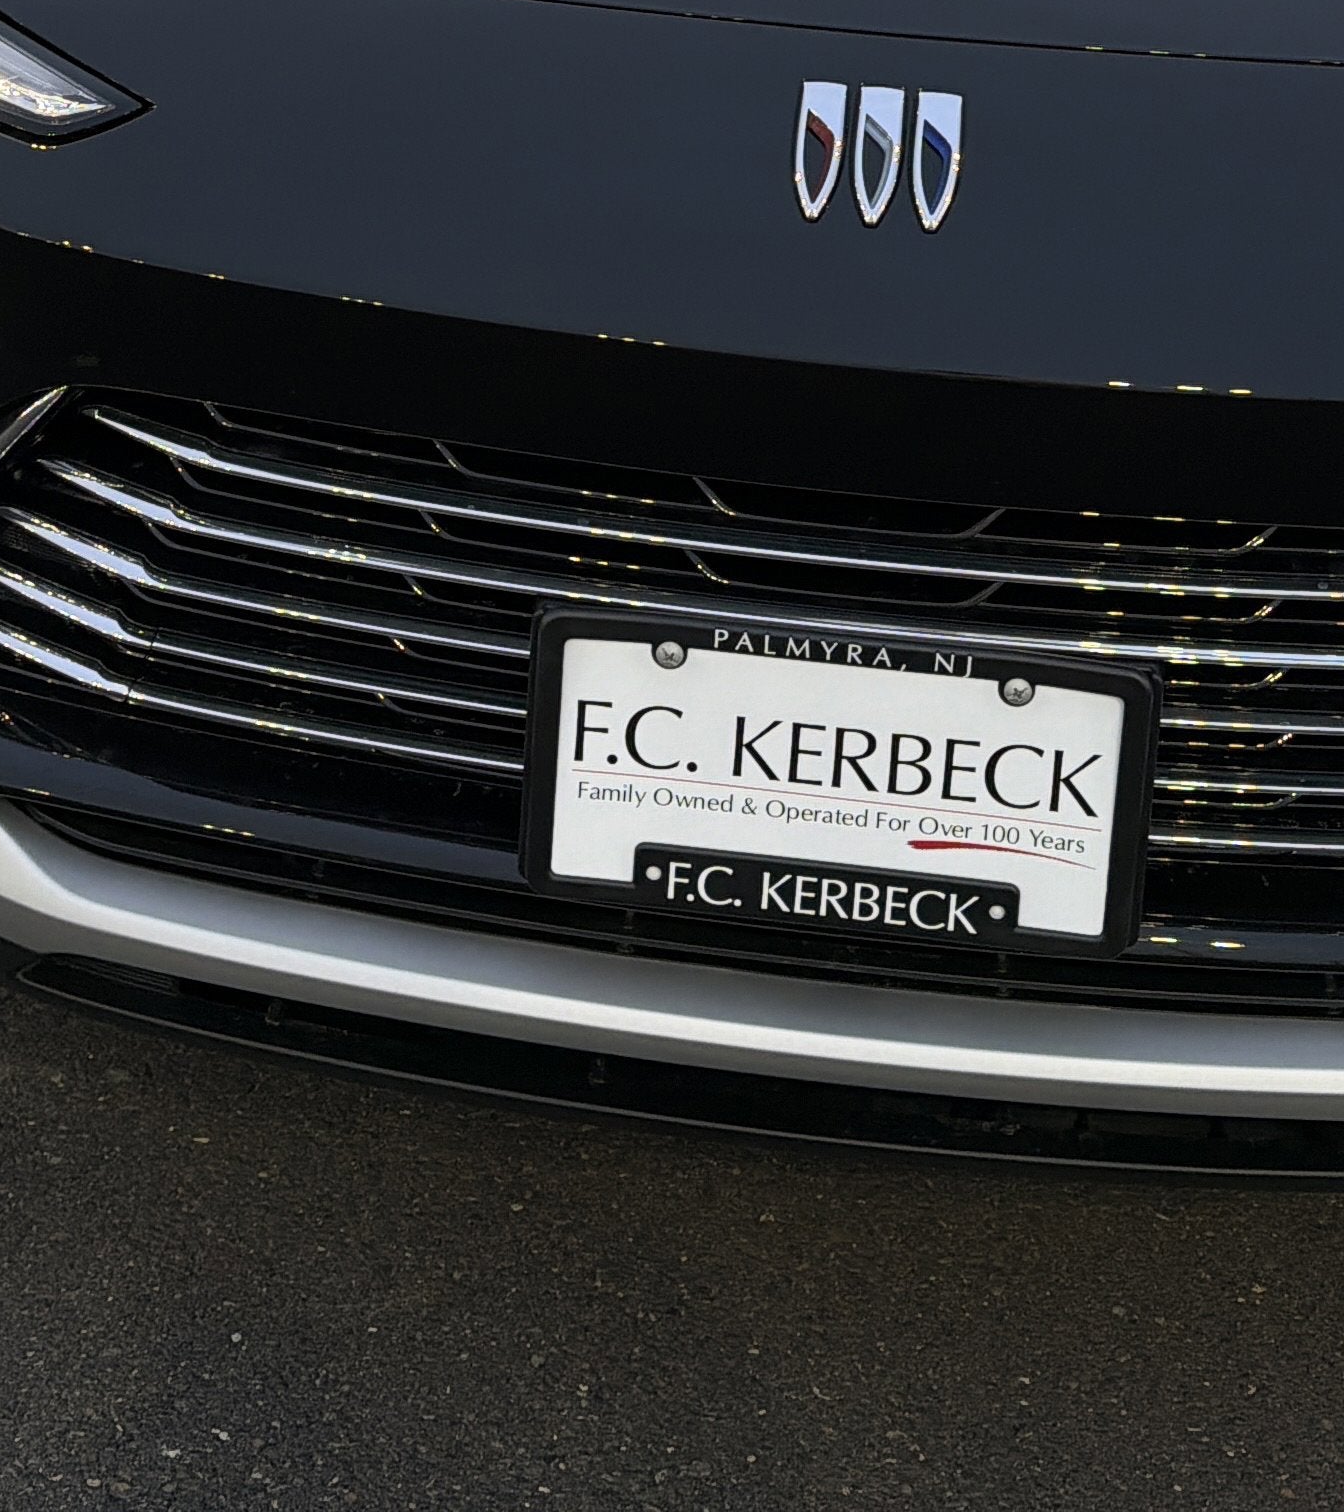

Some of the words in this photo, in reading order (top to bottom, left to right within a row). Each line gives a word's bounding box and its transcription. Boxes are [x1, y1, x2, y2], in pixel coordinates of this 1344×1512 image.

[713, 628, 908, 672] PALMYRA,
[934, 652, 975, 678] NJ
[573, 699, 698, 773] F.C.
[731, 715, 1104, 818] KERBECK
[577, 781, 647, 807] Family
[653, 787, 734, 813] Owned
[741, 797, 757, 815] &
[765, 799, 869, 828] Operated
[875, 811, 911, 832] For
[918, 816, 973, 839] Over
[981, 824, 1020, 845] 100
[1029, 828, 1085, 854] Years
[666, 861, 742, 907] F.C.
[760, 871, 980, 935] KERBECK
